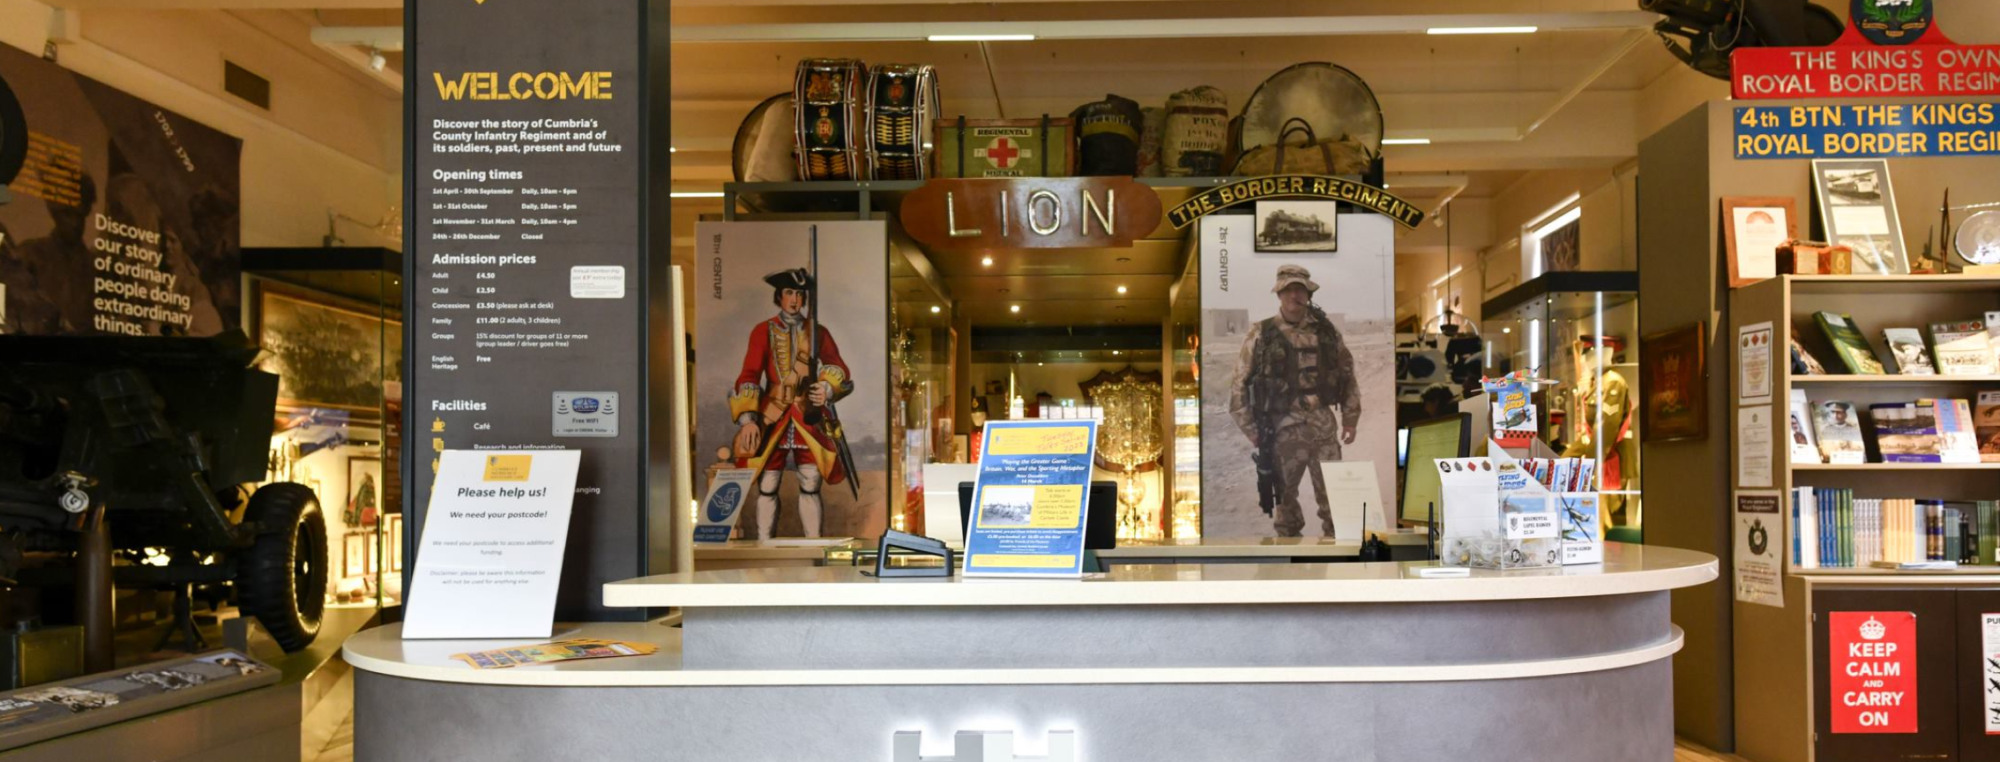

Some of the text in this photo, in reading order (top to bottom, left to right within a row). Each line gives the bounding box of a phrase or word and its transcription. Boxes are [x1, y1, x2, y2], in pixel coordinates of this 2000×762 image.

[1791, 51, 1836, 70] THE
[1852, 49, 1923, 70] KING'S
[432, 71, 612, 100] WELCOME
[1743, 74, 1816, 94] ROYAL
[1829, 73, 1924, 92] BORDER
[1740, 107, 1780, 128] 4th
[1852, 105, 1902, 126] THE
[1912, 103, 1994, 125] KINGS
[432, 118, 598, 130] Discover the story of Cumbria's
[432, 130, 607, 142] County Infantry Regiment and of
[1738, 130, 2000, 155] ROYAL BORDER REGI
[432, 142, 622, 154] its soldiers, past, present and future
[432, 168, 523, 182] Opening times
[432, 188, 442, 196] 1st
[443, 188, 458, 196] April
[480, 188, 514, 196] September
[522, 188, 539, 196] Daily,
[1172, 178, 1420, 228] THE BORDER REGIMENT
[947, 188, 1115, 237] LION
[94, 213, 160, 245] Discover
[522, 218, 539, 226] Daily,
[94, 237, 162, 268] our story
[432, 253, 536, 266] Admission prices
[94, 256, 176, 290] of ordinary
[1219, 248, 1228, 292] CENTURY
[713, 257, 722, 300] CENTURY
[94, 276, 190, 310] people doing
[94, 297, 192, 328] extraordinary
[496, 302, 518, 310] (please
[537, 302, 554, 310] desk)
[432, 317, 452, 326] Family
[476, 316, 499, 324] £11.00
[534, 316, 561, 324] children)
[497, 340, 516, 348] leader
[521, 340, 538, 348] driver
[432, 355, 454, 363] English
[432, 363, 458, 371] Heritage
[432, 400, 487, 411] Facilities
[473, 422, 490, 430] Café
[457, 487, 546, 499] Please help us!
[507, 510, 548, 519] postcode!
[1849, 642, 1898, 657] KEEP
[1846, 662, 1900, 676] CALM
[1863, 680, 1884, 688] AND
[1843, 692, 1904, 706] CARRY
[1859, 712, 1888, 726] ON
